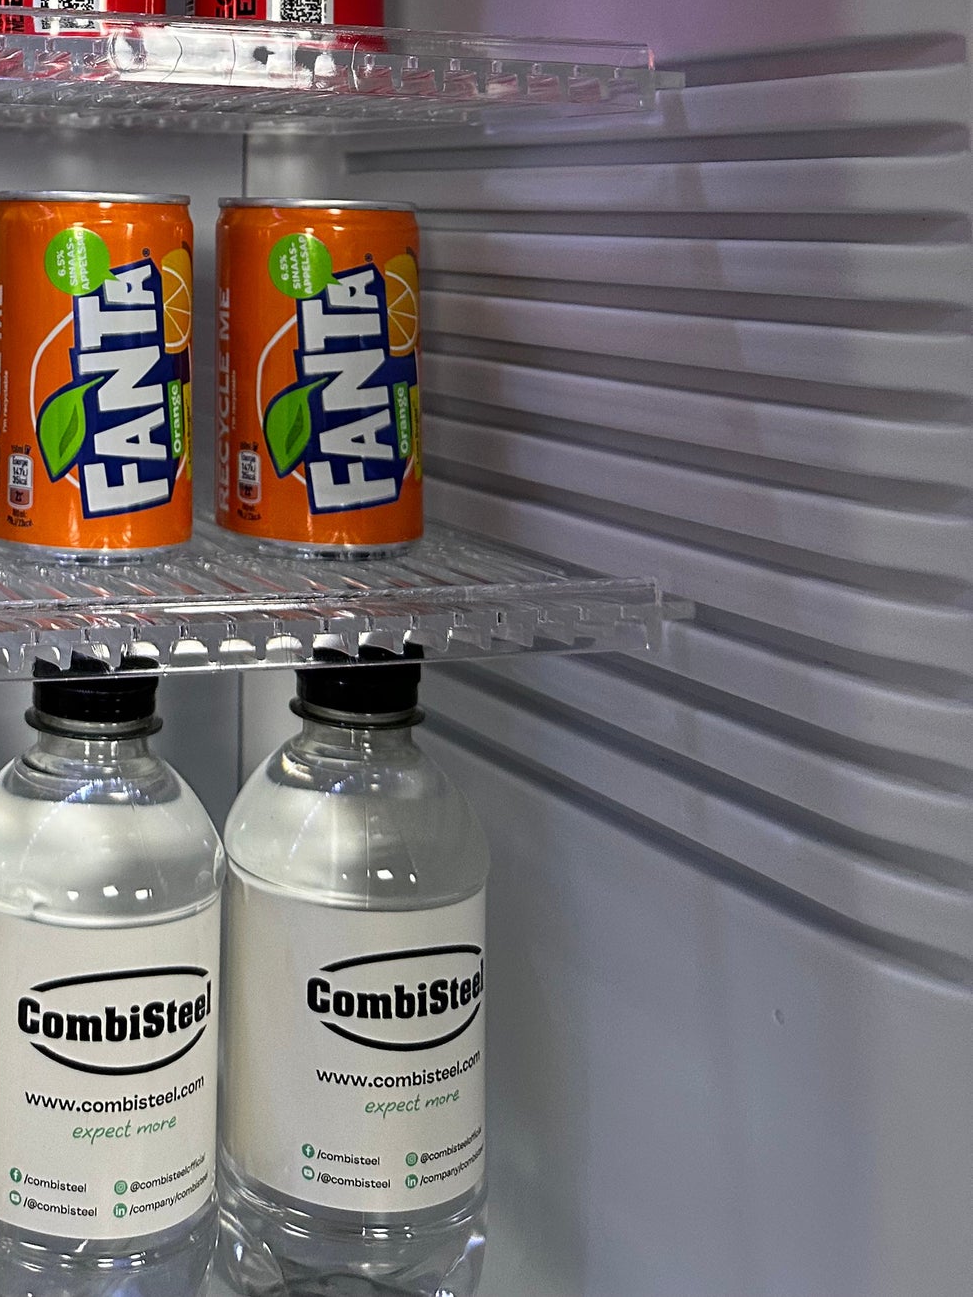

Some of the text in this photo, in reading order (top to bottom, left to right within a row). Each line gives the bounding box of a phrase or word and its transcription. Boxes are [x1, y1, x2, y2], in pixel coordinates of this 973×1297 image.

[56, 249, 67, 278] 6.5%
[278, 254, 290, 281] 6.5%
[288, 242, 302, 290] SINAAS-
[298, 235, 314, 295] APPELSAP
[218, 287, 231, 341] ME
[78, 264, 170, 513] FANTA
[302, 269, 397, 509] FANTA
[171, 384, 182, 454] Orange
[306, 958, 485, 1020] CombiSteel
[16, 980, 212, 1043] CombiSteel
[315, 1049, 481, 1089] www.combisteel.com
[24, 1075, 205, 1114] www.combisteel.com
[364, 1087, 461, 1119] expect more
[72, 1114, 177, 1145] expect more
[316, 1147, 381, 1167] /combisteel
[23, 1174, 88, 1194] /combisteel
[316, 1171, 392, 1190] /@combisteel
[22, 1196, 98, 1218] /@combisteel
